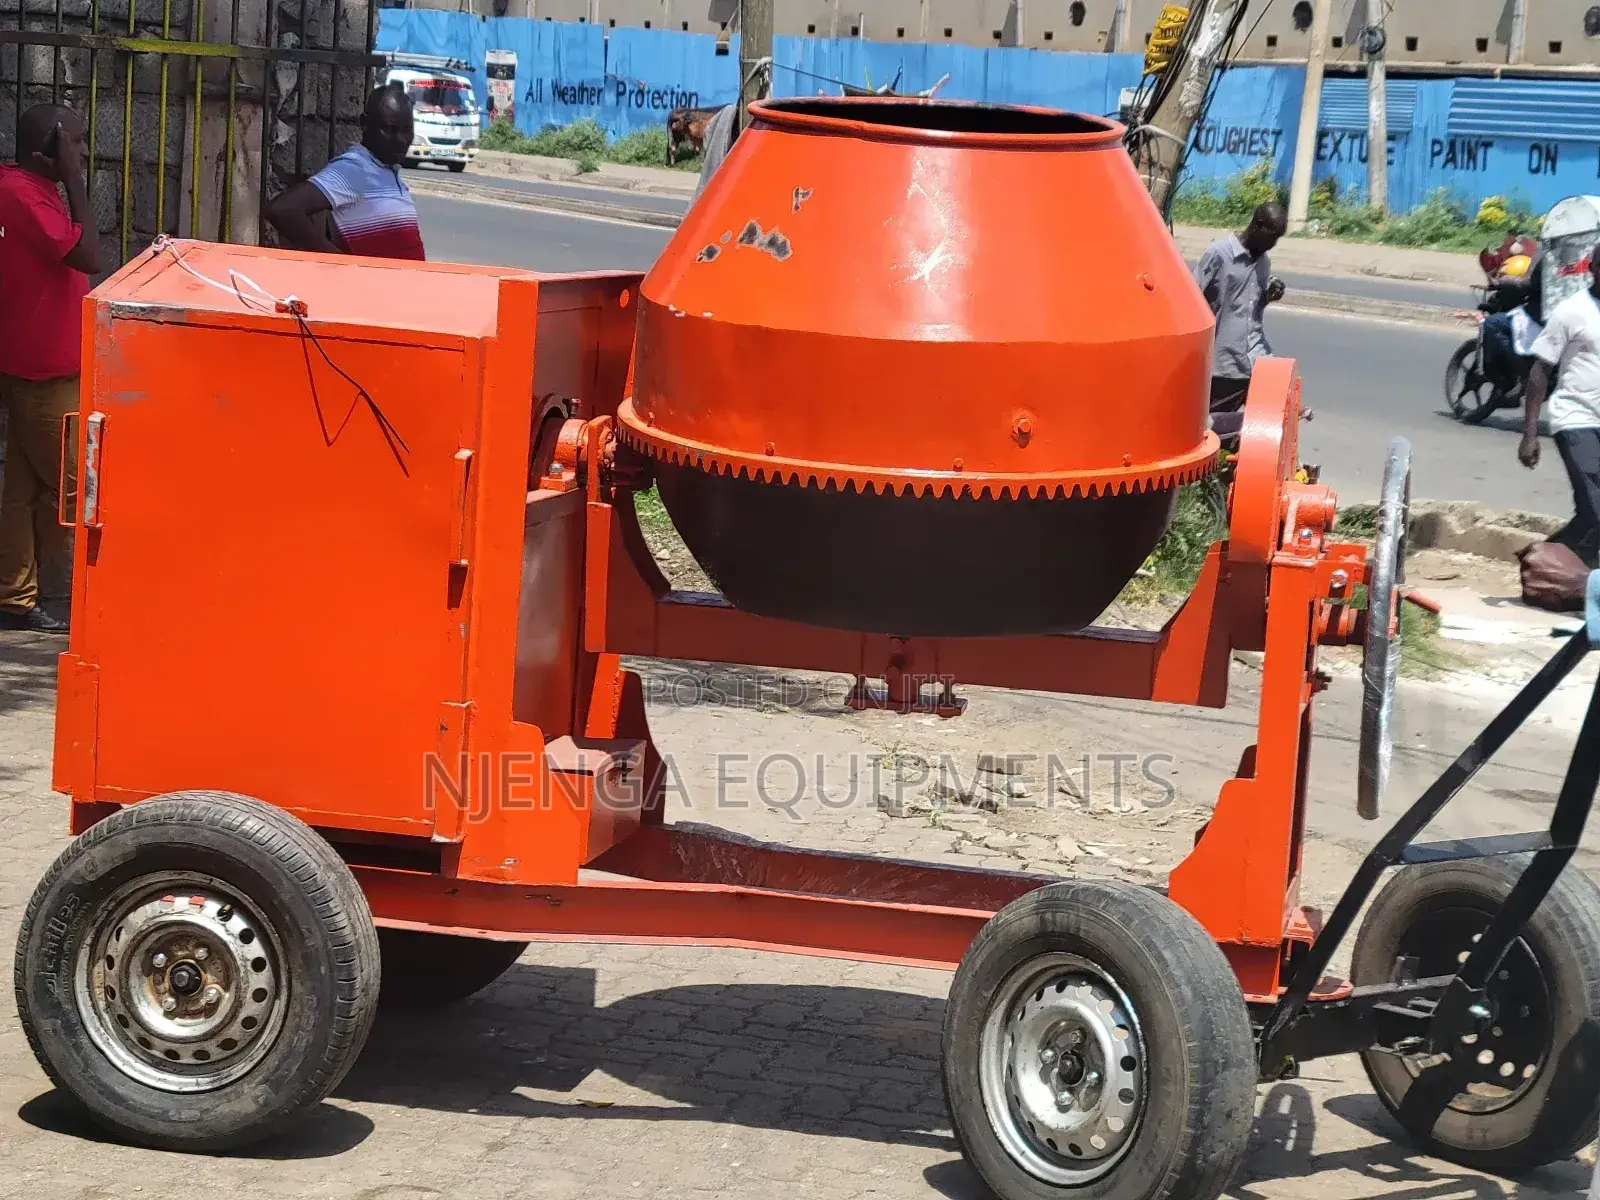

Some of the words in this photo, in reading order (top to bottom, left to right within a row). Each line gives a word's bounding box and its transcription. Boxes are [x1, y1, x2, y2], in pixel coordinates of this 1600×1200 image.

[525, 77, 543, 104] All
[551, 79, 604, 106] Weather
[616, 80, 699, 110] Protection
[1195, 125, 1283, 157] TOUGHEST
[1315, 128, 1397, 165] EXTUE
[1430, 137, 1494, 172] PAINT
[1528, 142, 1559, 175] ON
